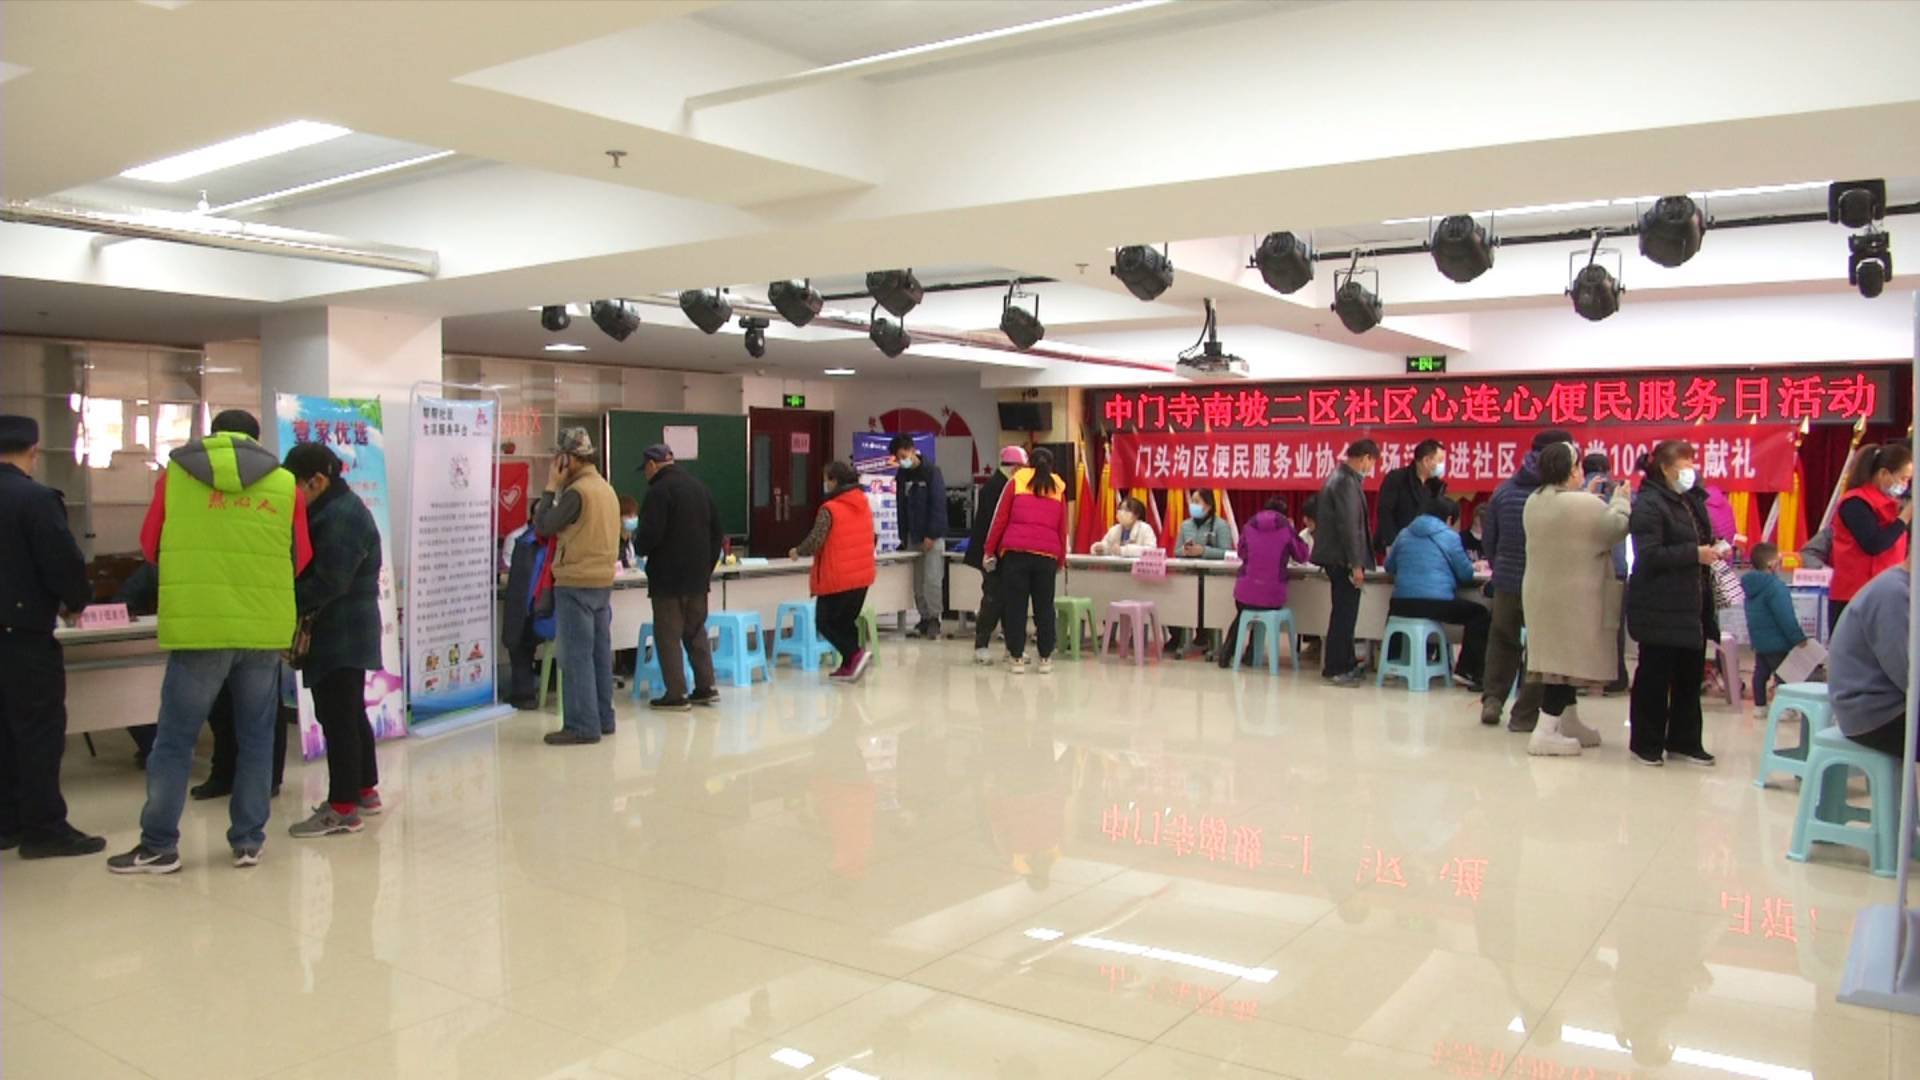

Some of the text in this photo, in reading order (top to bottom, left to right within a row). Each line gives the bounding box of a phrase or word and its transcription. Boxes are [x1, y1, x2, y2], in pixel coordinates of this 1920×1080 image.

[1105, 373, 1876, 430] 中门寺南坡二区社区心连心便民服务日活动
